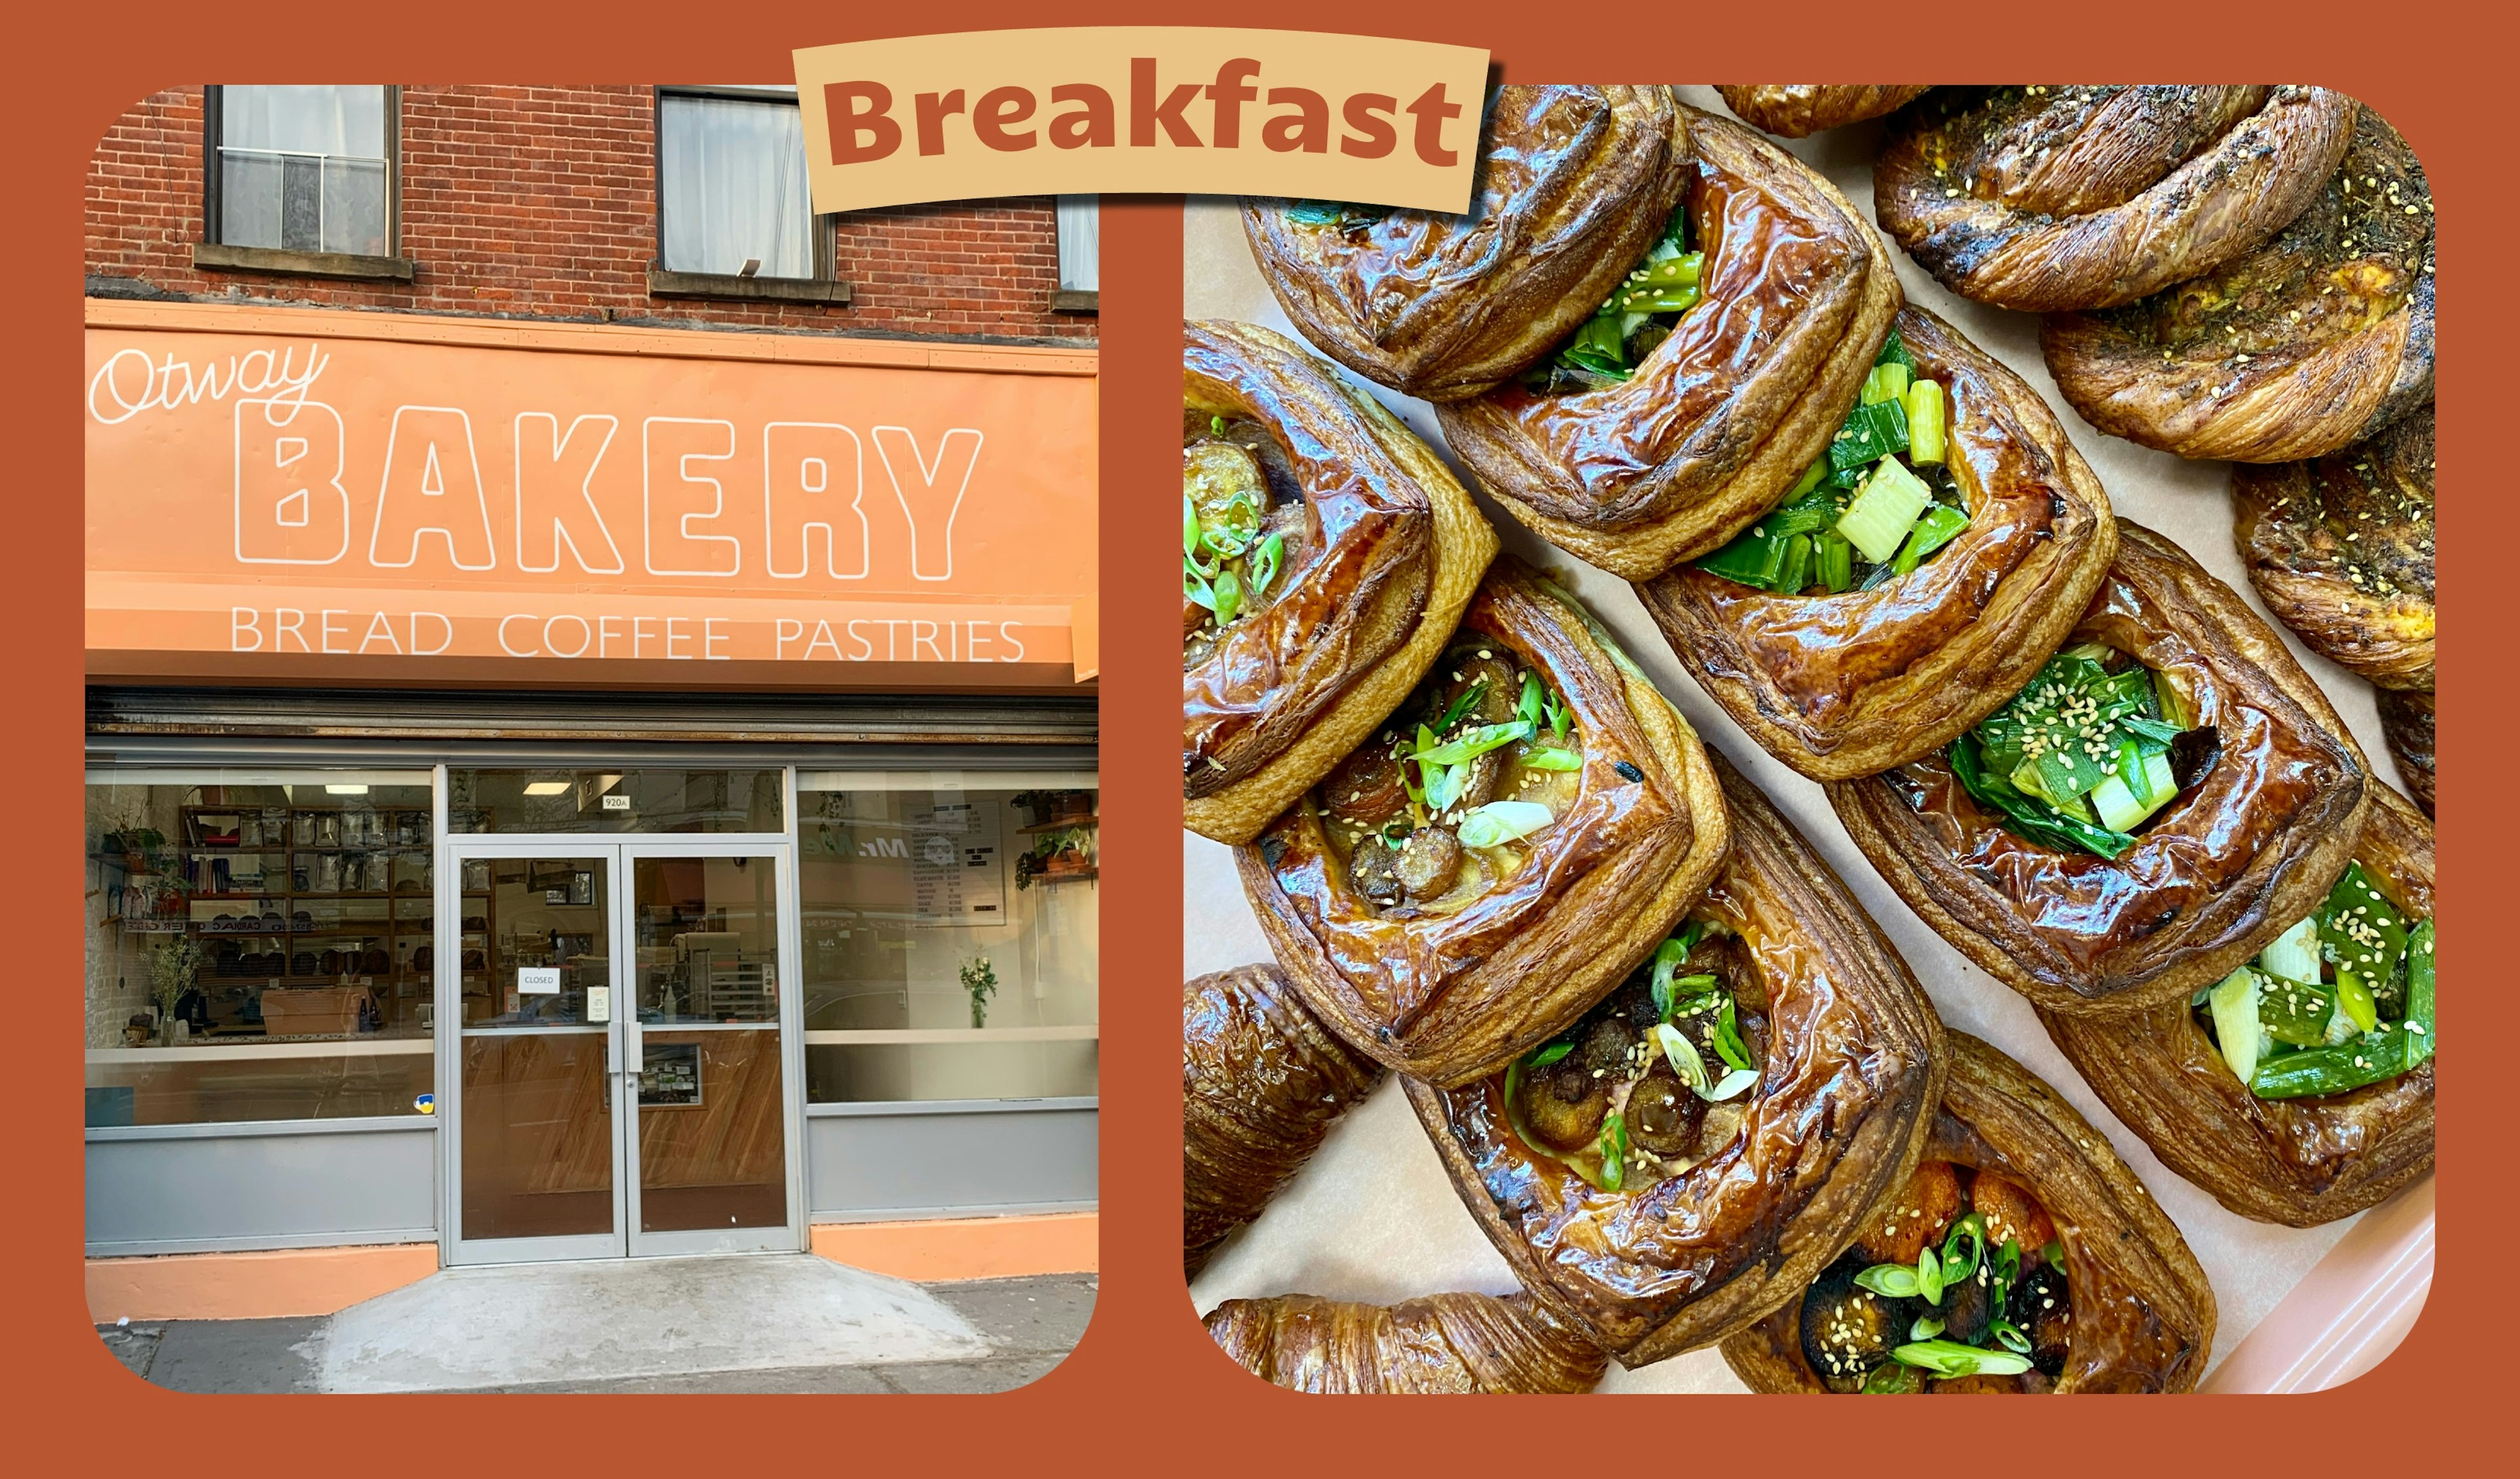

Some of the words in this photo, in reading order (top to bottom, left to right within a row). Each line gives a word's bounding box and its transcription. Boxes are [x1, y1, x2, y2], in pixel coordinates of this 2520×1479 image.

[88, 343, 330, 427] Otway
[234, 398, 984, 581] BAKERY
[232, 606, 453, 656] BREAD
[498, 614, 731, 660] COFFEE
[776, 618, 1024, 663] PASTRIES
[606, 798, 627, 807] 920A
[524, 976, 554, 984] CLOSED
